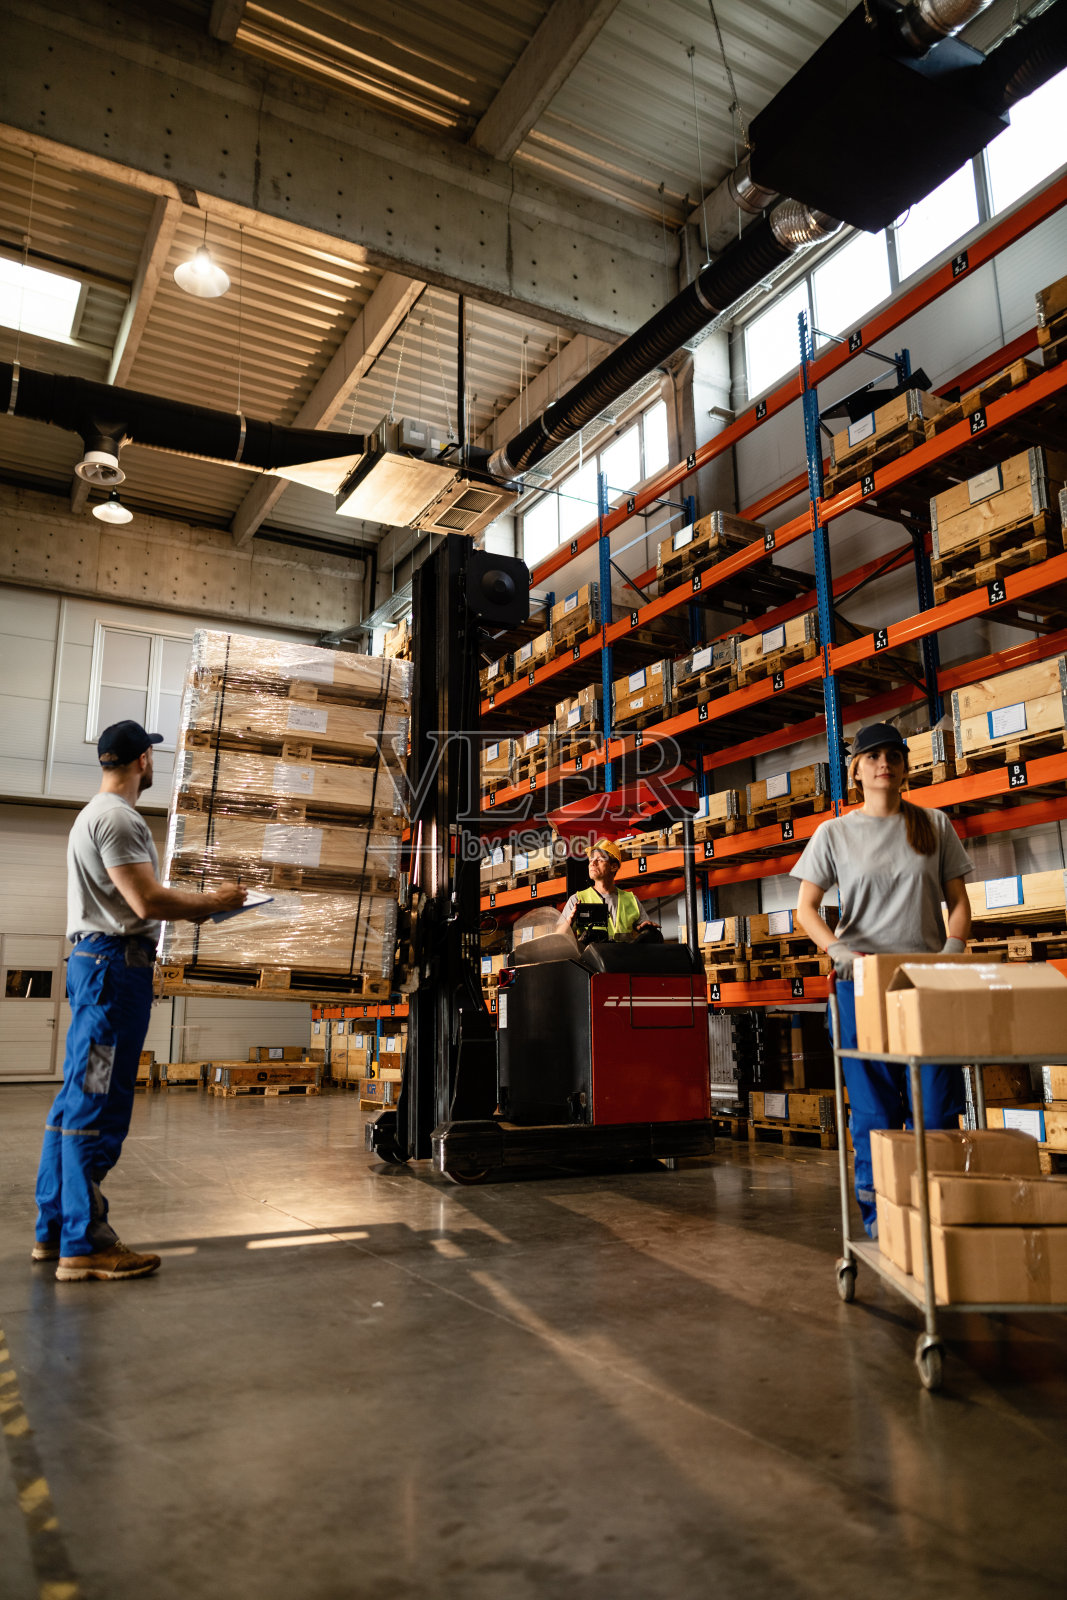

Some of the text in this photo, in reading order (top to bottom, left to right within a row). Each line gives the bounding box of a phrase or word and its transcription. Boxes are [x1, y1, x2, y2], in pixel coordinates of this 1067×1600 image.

[955, 261, 966, 274] 5.2
[975, 412, 980, 422] D
[972, 419, 985, 432] 5.2
[863, 483, 873, 494] 5.1
[993, 582, 999, 591] C
[991, 591, 1004, 603] 5.2
[876, 638, 886, 649] 5.1
[774, 680, 783, 689] 4.3
[1013, 765, 1020, 775] B
[1011, 774, 1025, 785] 5.2
[783, 829, 793, 838] 4.3
[793, 987, 803, 995] 4.3
